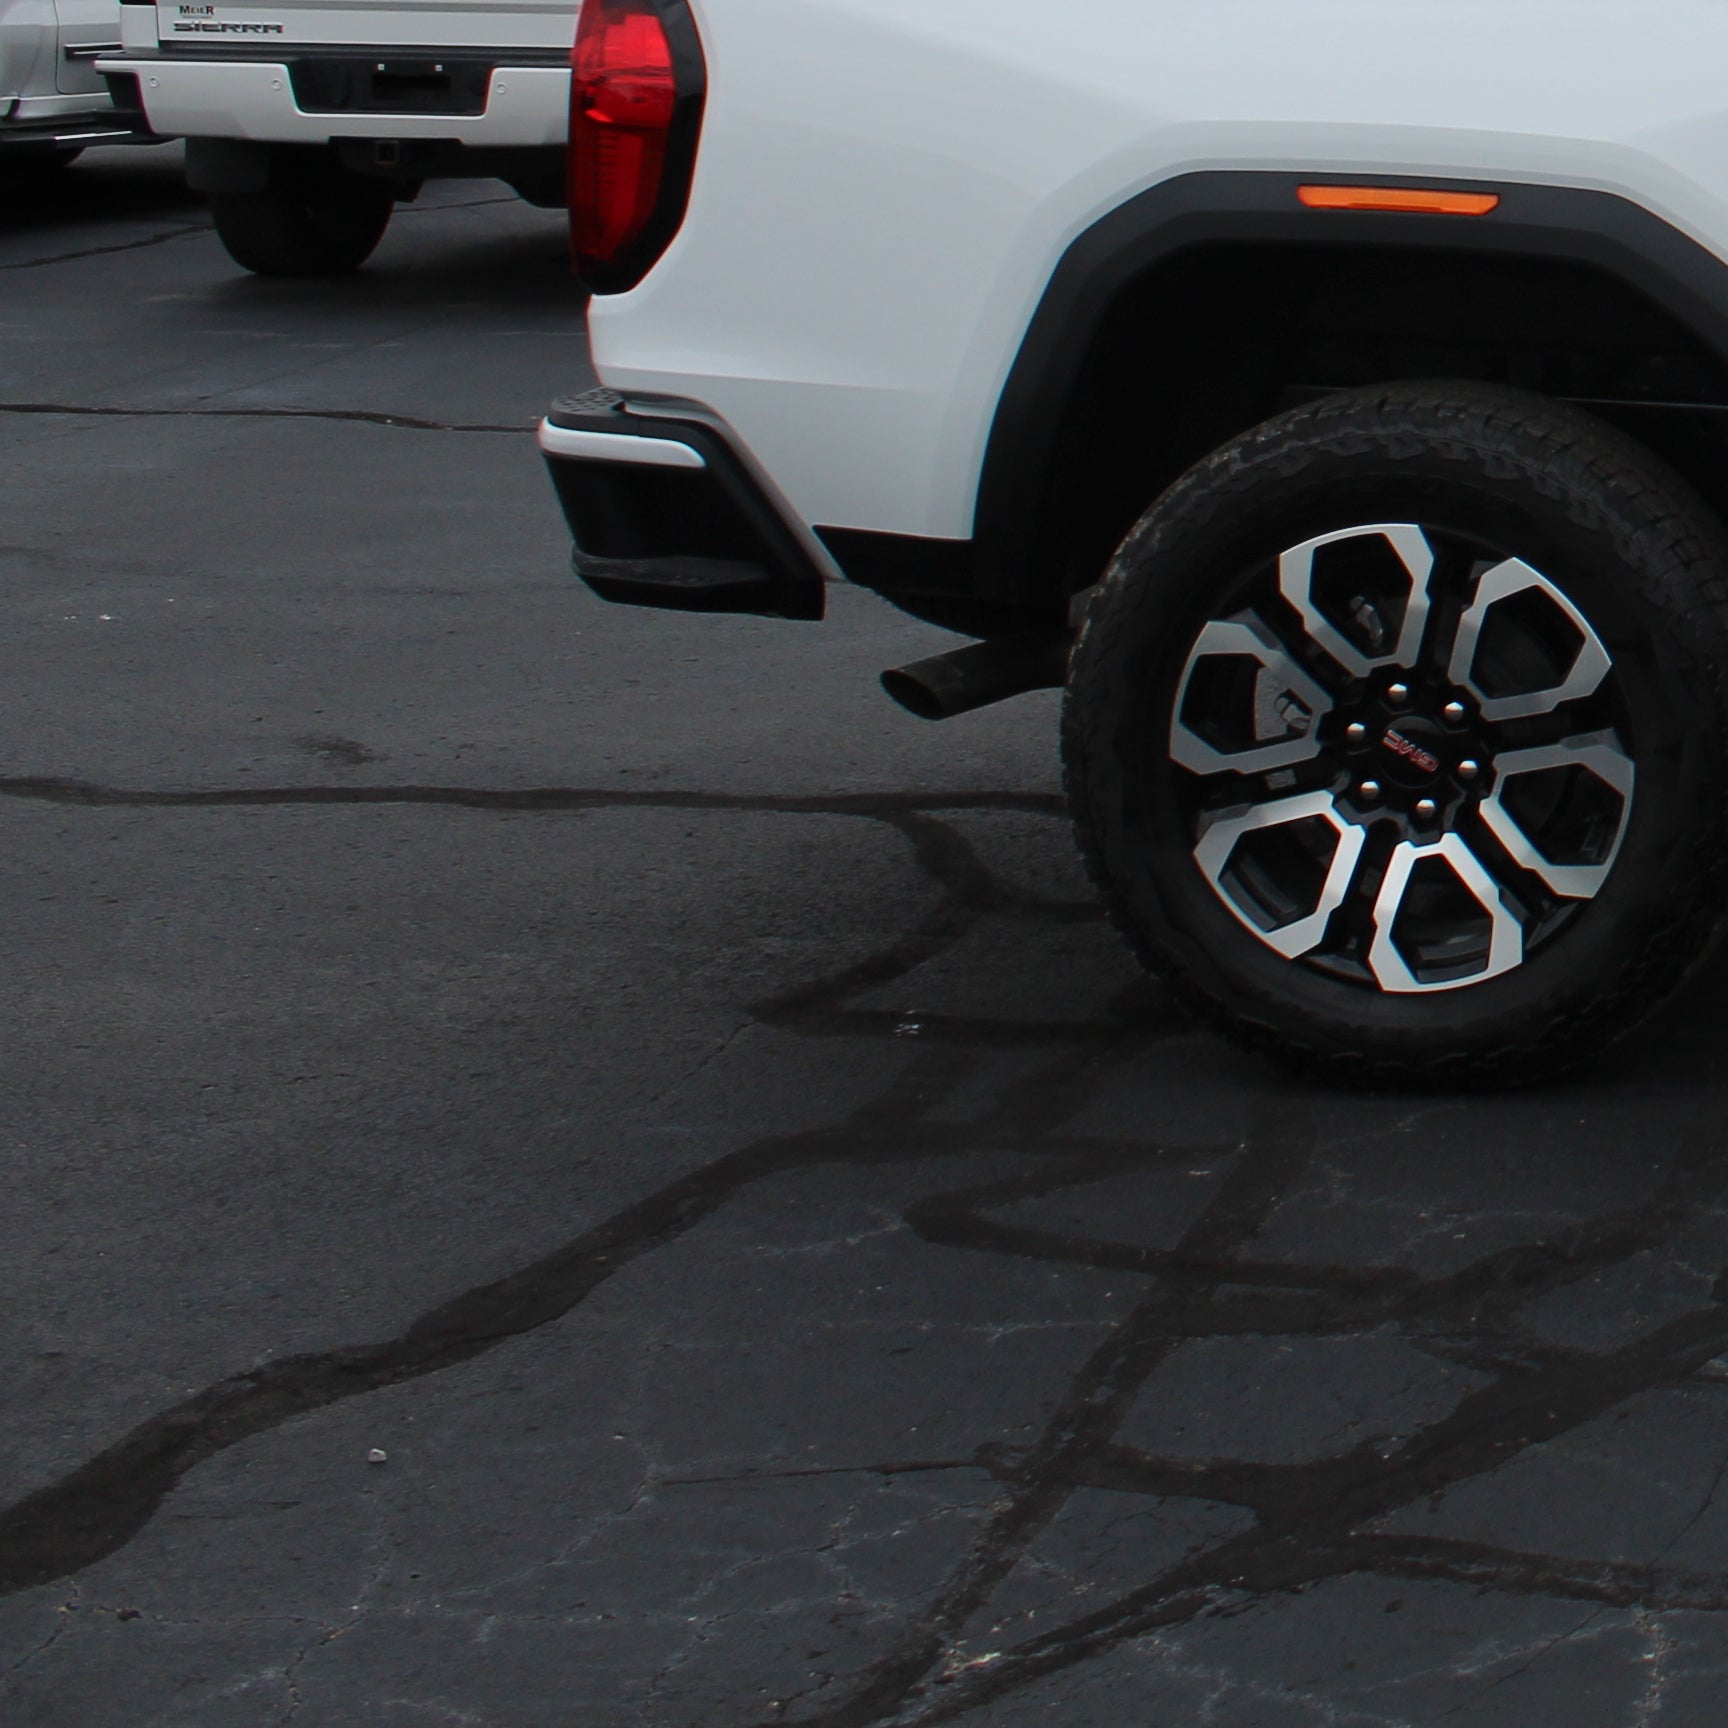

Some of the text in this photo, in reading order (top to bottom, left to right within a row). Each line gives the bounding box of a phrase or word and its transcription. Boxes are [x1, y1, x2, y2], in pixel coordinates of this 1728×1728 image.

[179, 5, 214, 15] MEIER
[173, 22, 284, 34] SIERRA
[1381, 729, 1440, 773] GMC
